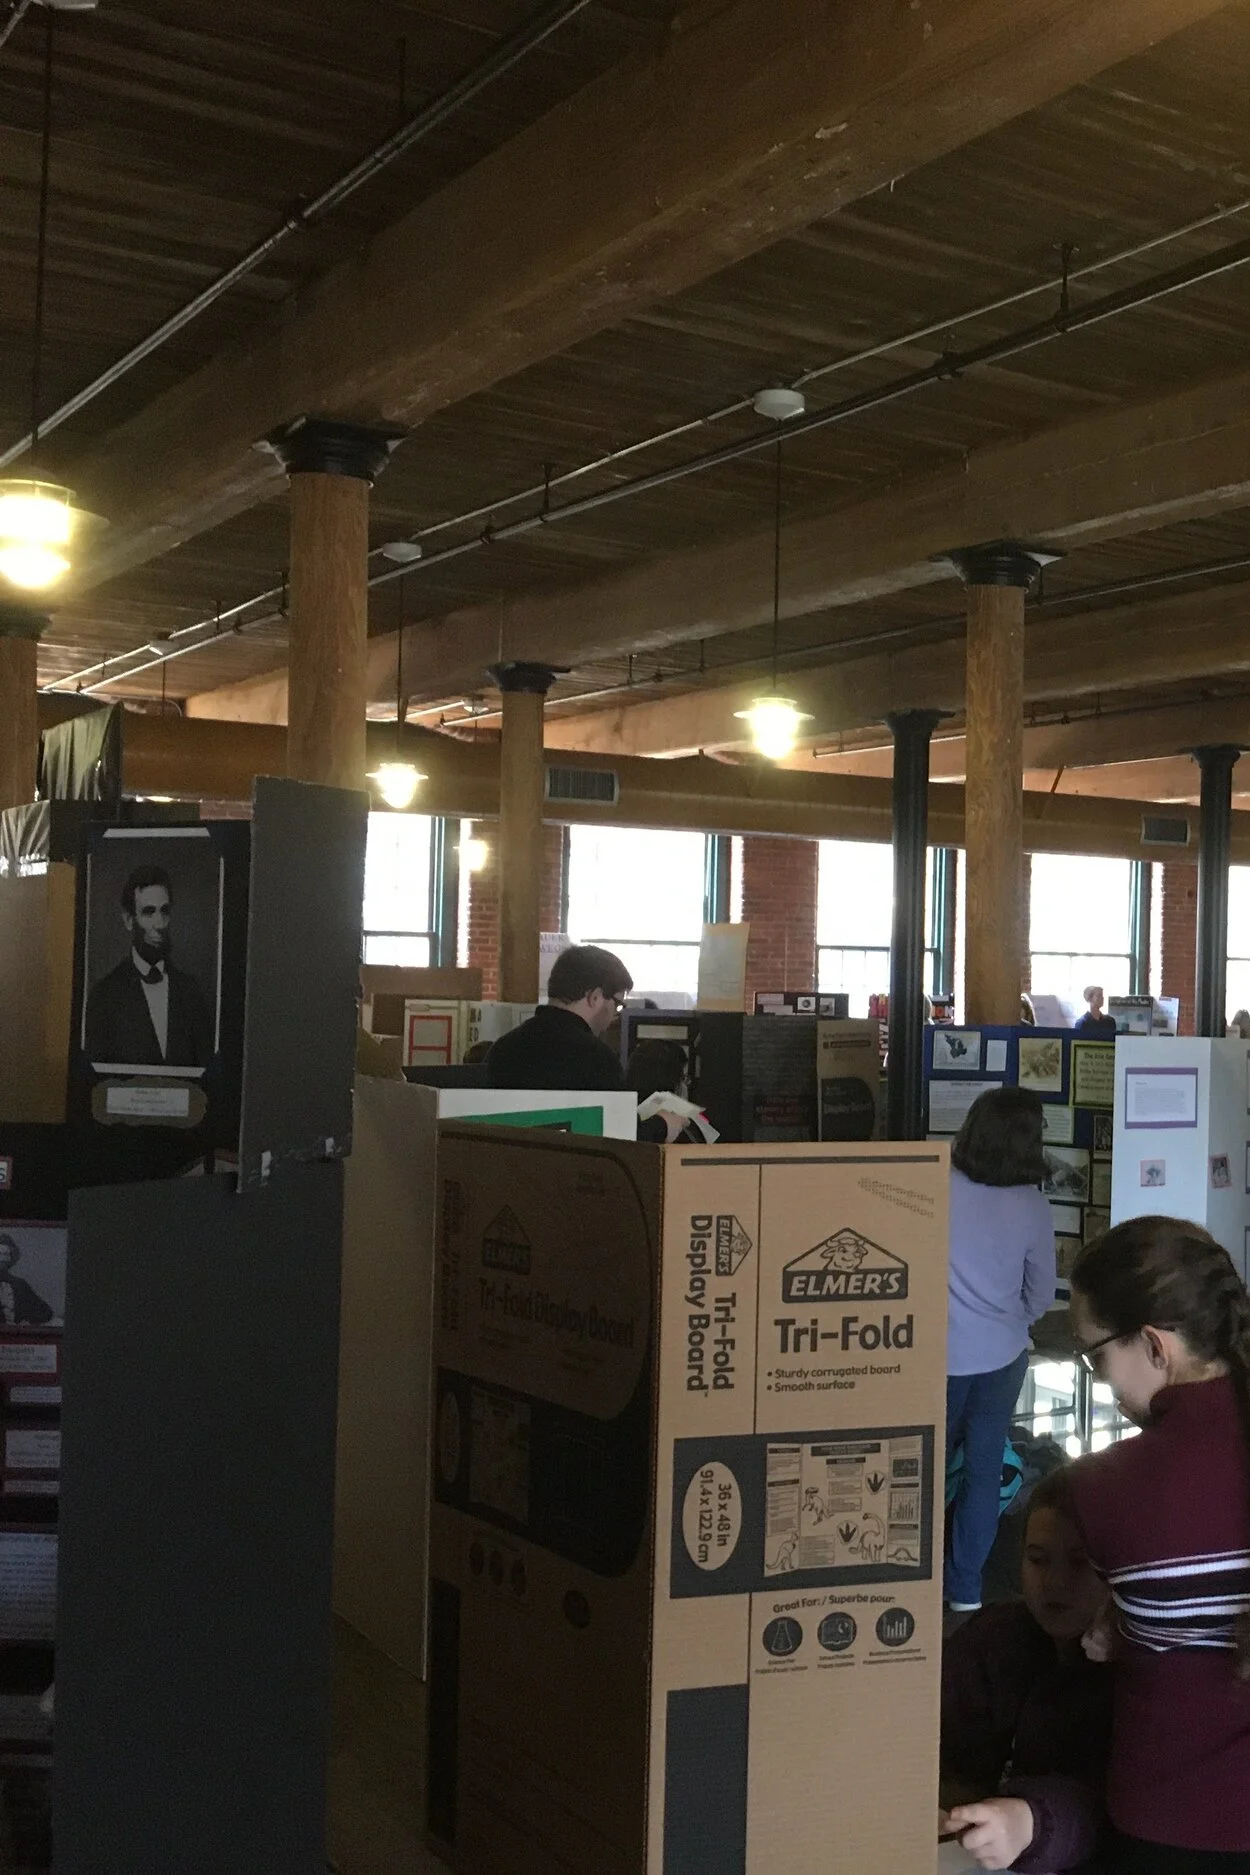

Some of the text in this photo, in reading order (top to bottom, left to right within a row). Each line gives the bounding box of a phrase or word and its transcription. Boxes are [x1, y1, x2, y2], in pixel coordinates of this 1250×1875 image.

[719, 1218, 733, 1275] ELMER'S
[790, 1272, 902, 1297] ELMER'S
[685, 1215, 713, 1391] Display Board
[713, 1292, 737, 1391] Tri-Fold
[773, 1314, 914, 1354] Tri-Fold
[775, 1364, 901, 1380] Sturdy corrugated board
[775, 1379, 856, 1393] Smooth surface
[716, 1483, 732, 1547] 36 x 48 in
[698, 1543, 709, 1562] cm
[773, 1600, 801, 1613] Great
[802, 1598, 821, 1609] For:
[828, 1594, 868, 1605] Superbe
